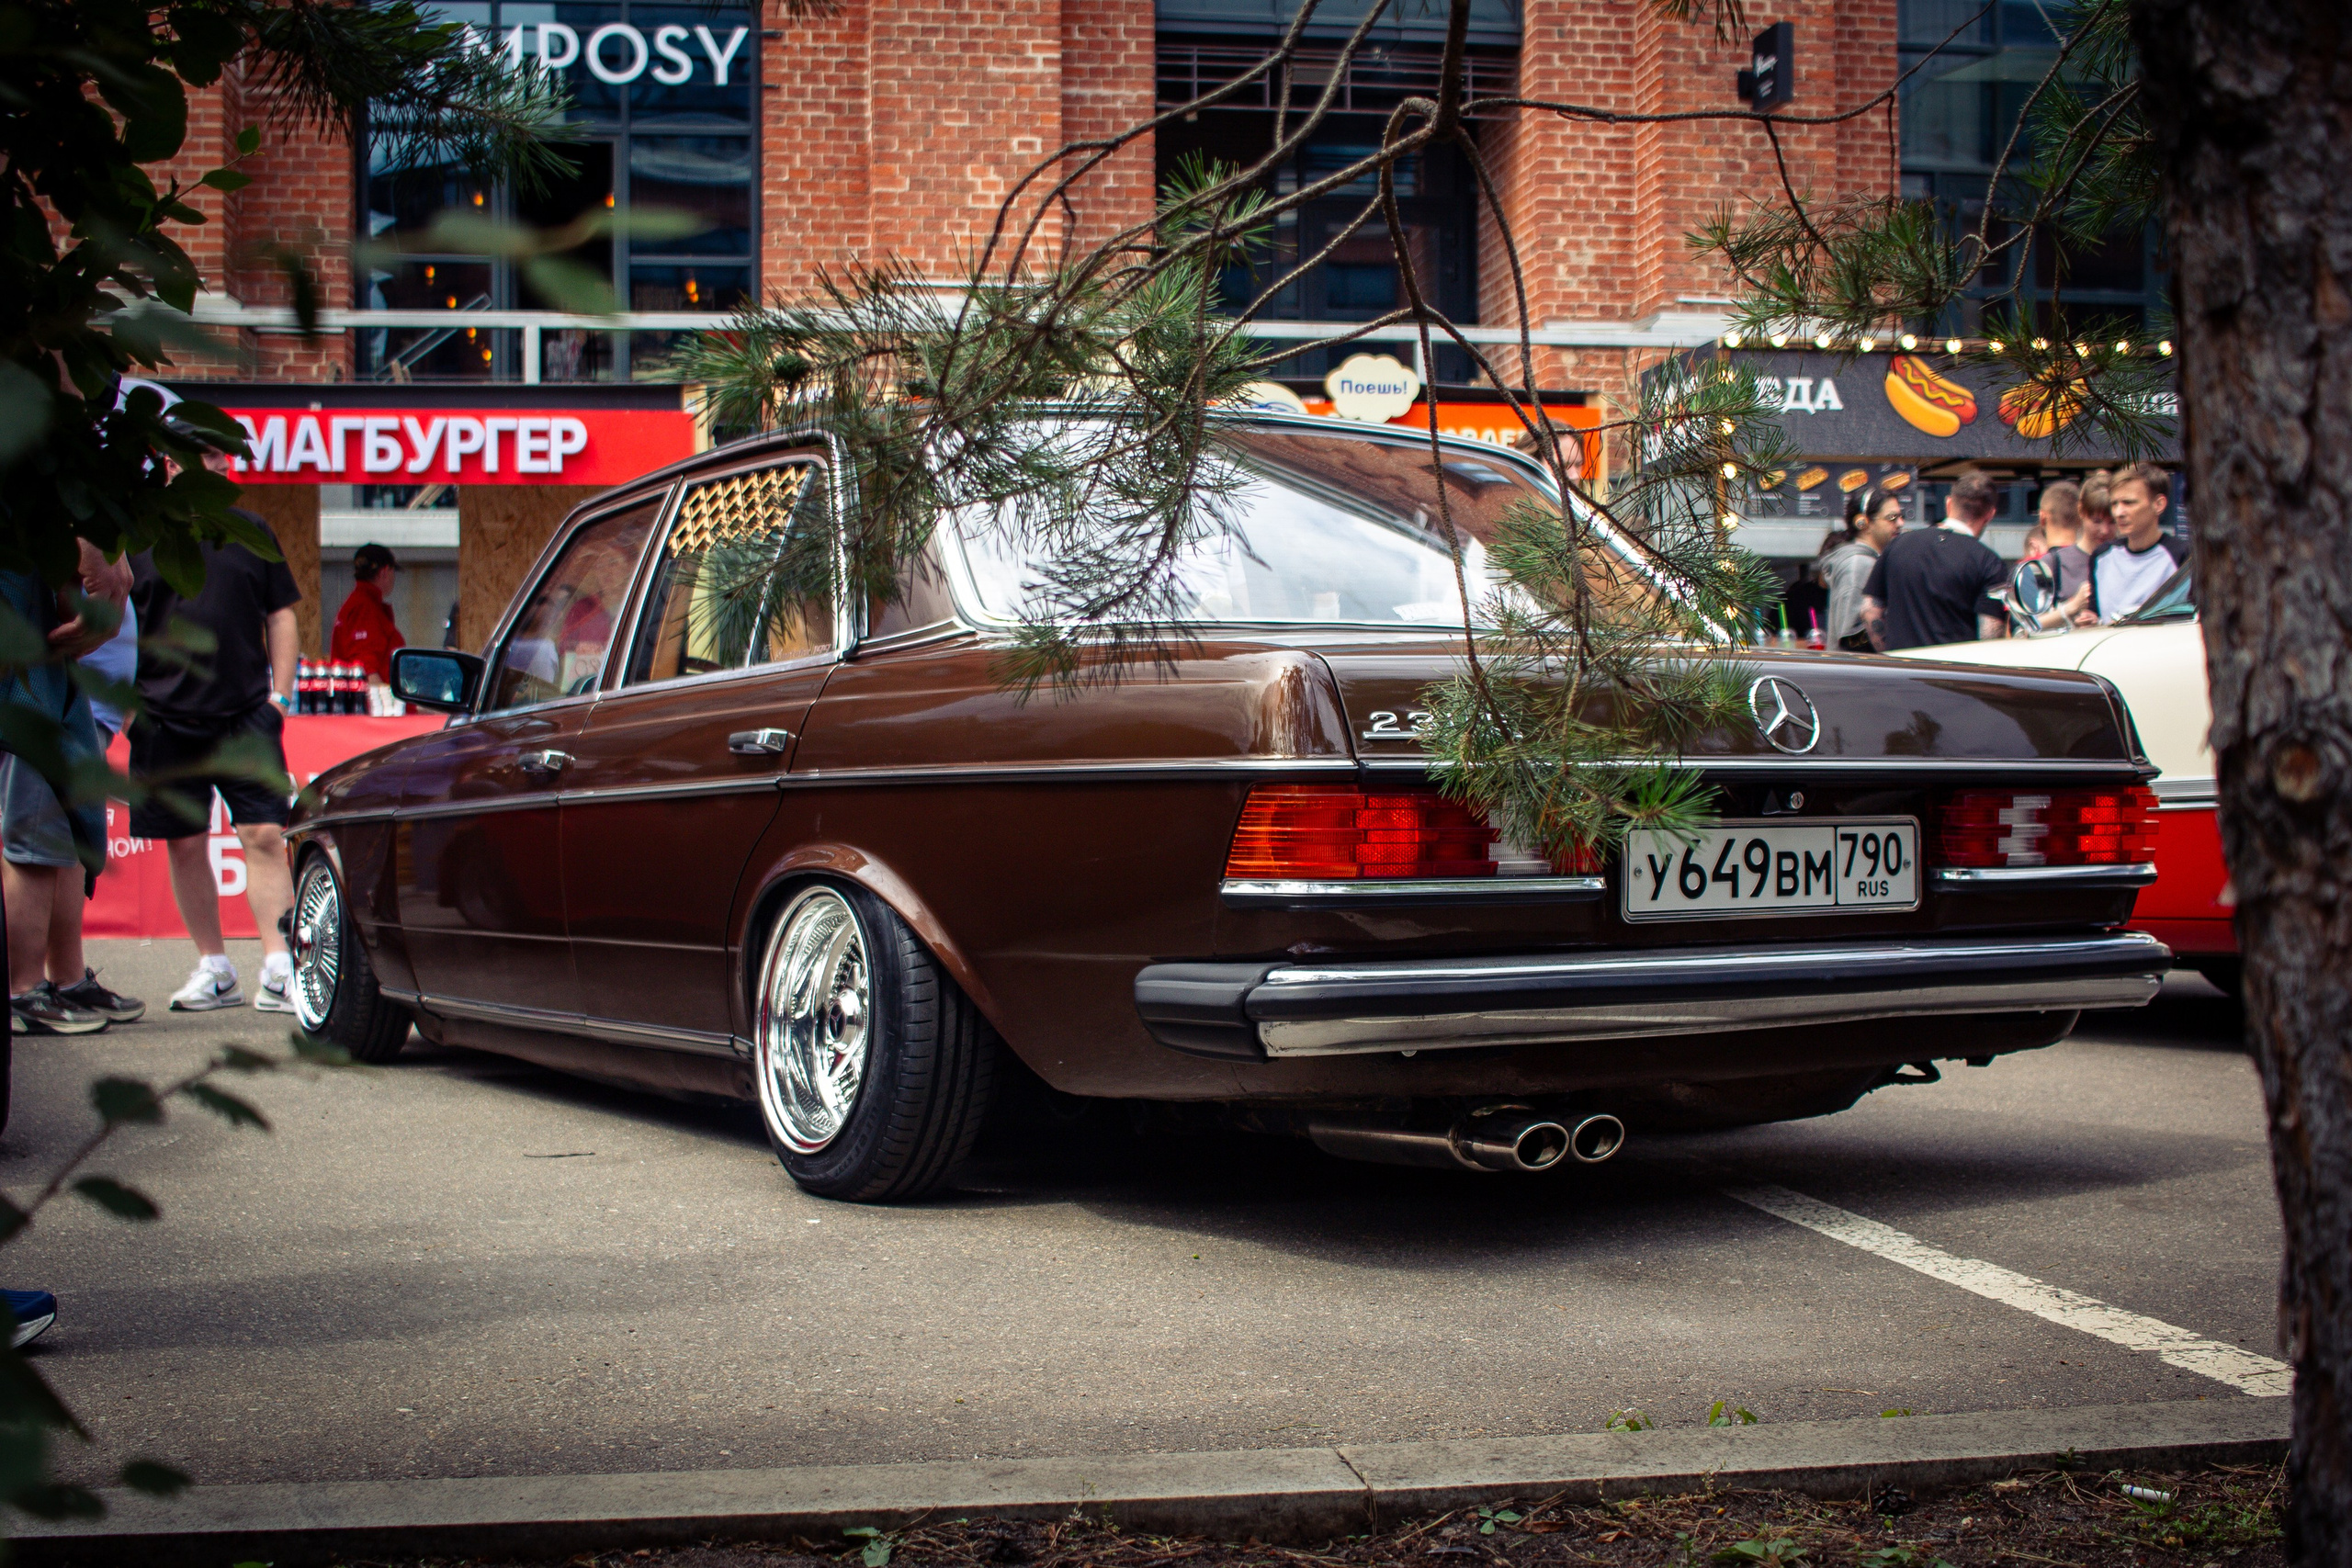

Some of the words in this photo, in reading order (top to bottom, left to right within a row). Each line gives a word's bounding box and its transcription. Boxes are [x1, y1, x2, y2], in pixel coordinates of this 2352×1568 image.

[1340, 379, 1408, 395] Поешь!
[234, 415, 588, 473] МАГБУРГЕР
[1647, 838, 1832, 901] У649ВМ
[1839, 832, 1903, 878] 790
[1859, 880, 1889, 897] RUS
